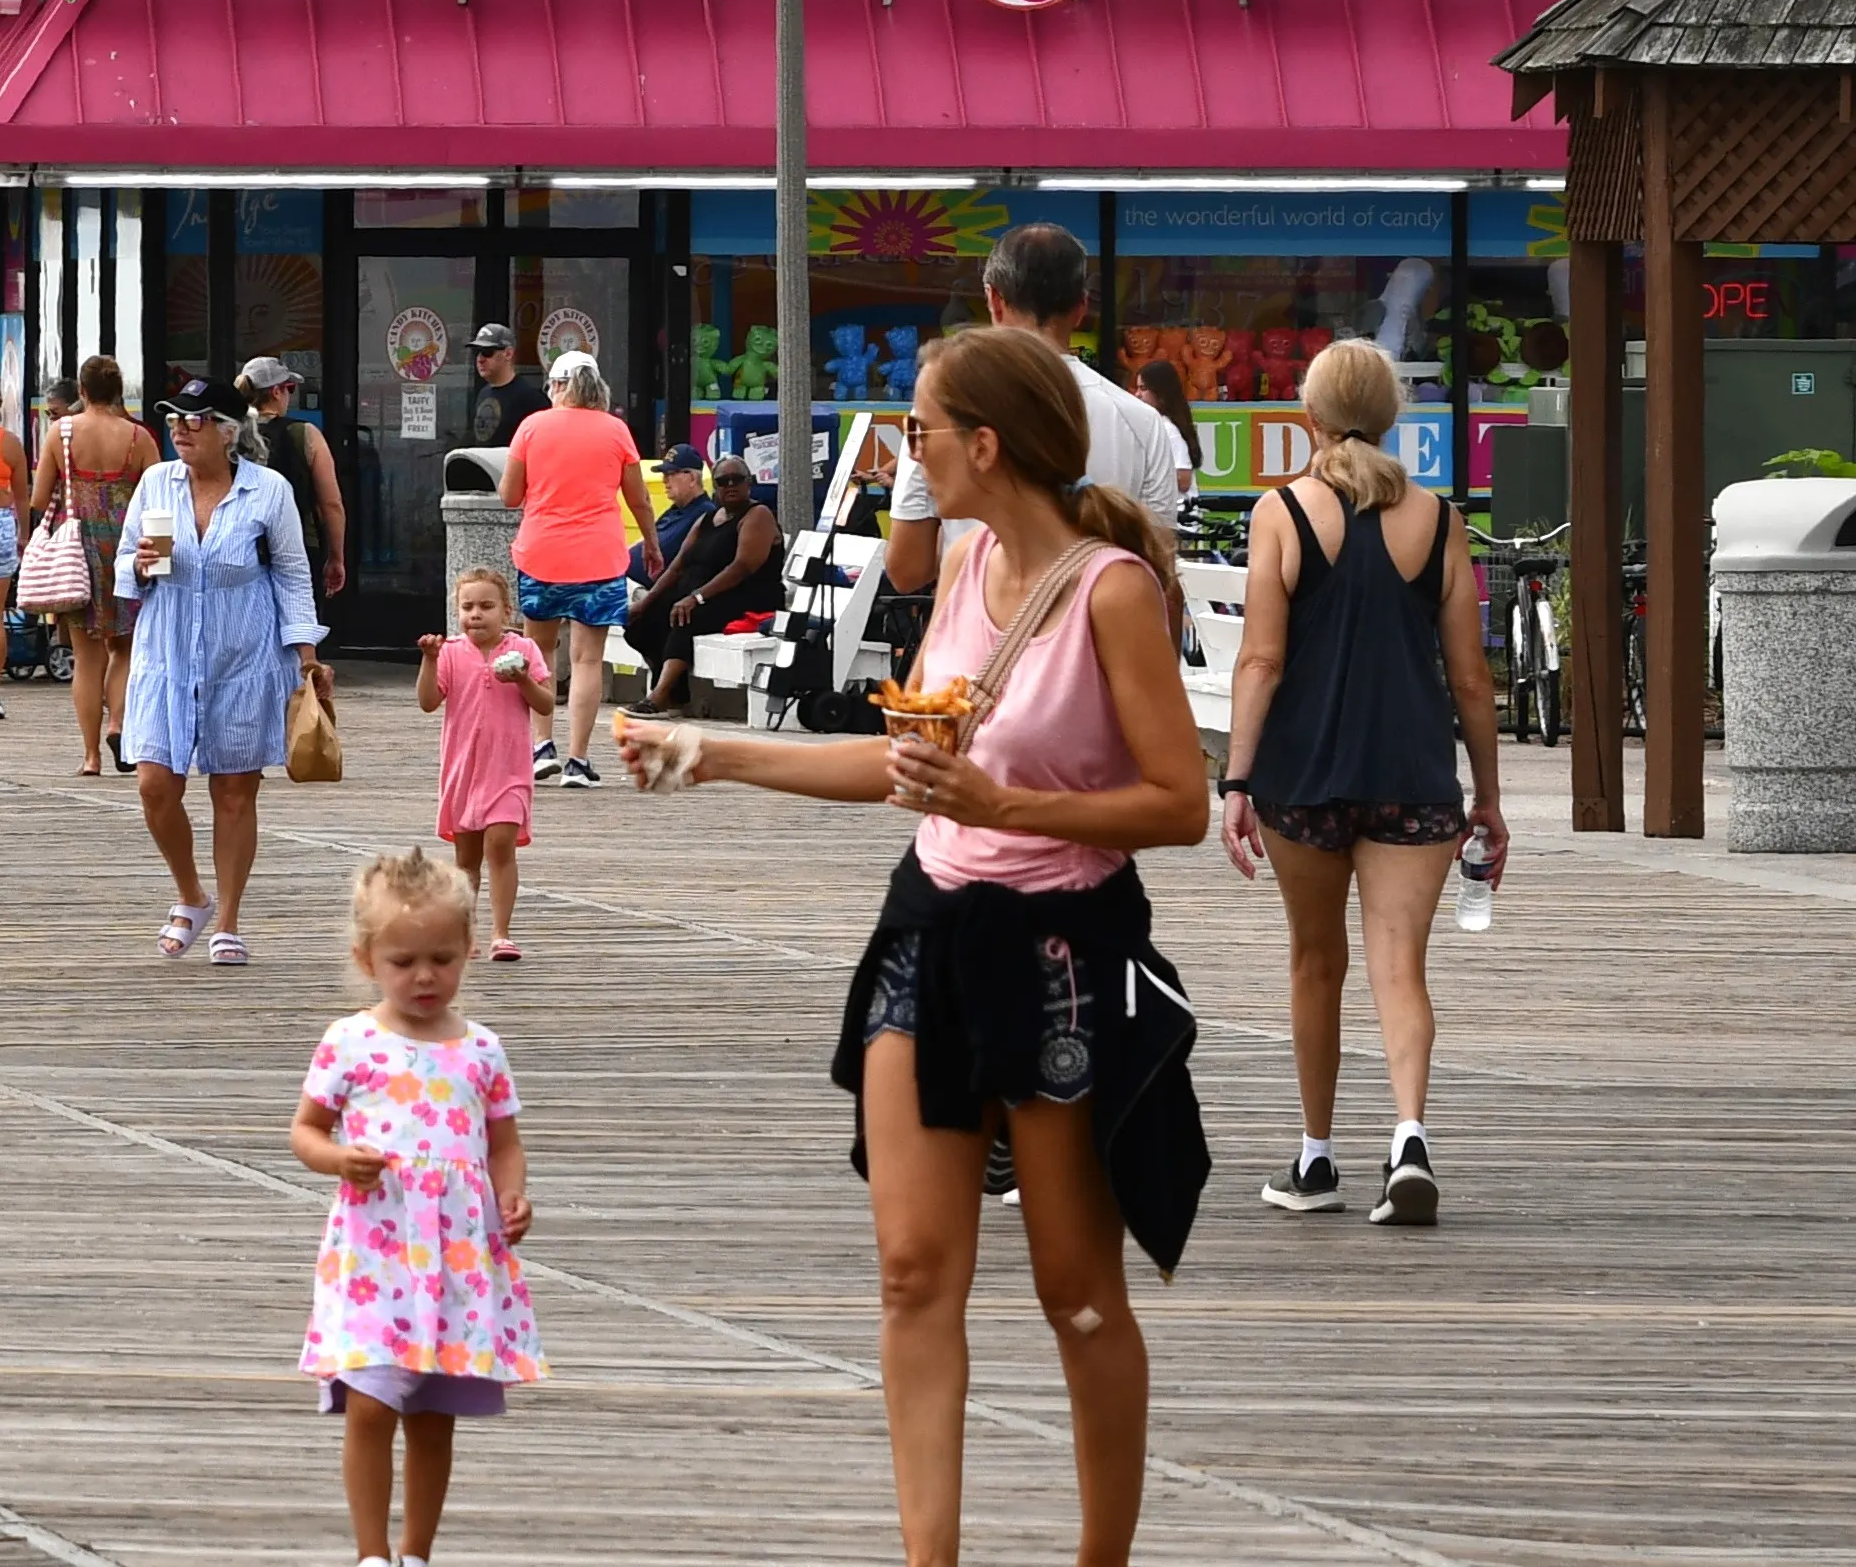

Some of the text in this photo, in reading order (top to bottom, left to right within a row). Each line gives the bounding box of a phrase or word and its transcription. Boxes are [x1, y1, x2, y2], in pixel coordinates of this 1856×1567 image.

[1124, 204, 1445, 232] the wonderful world of candy
[407, 396, 430, 405] TAFFY
